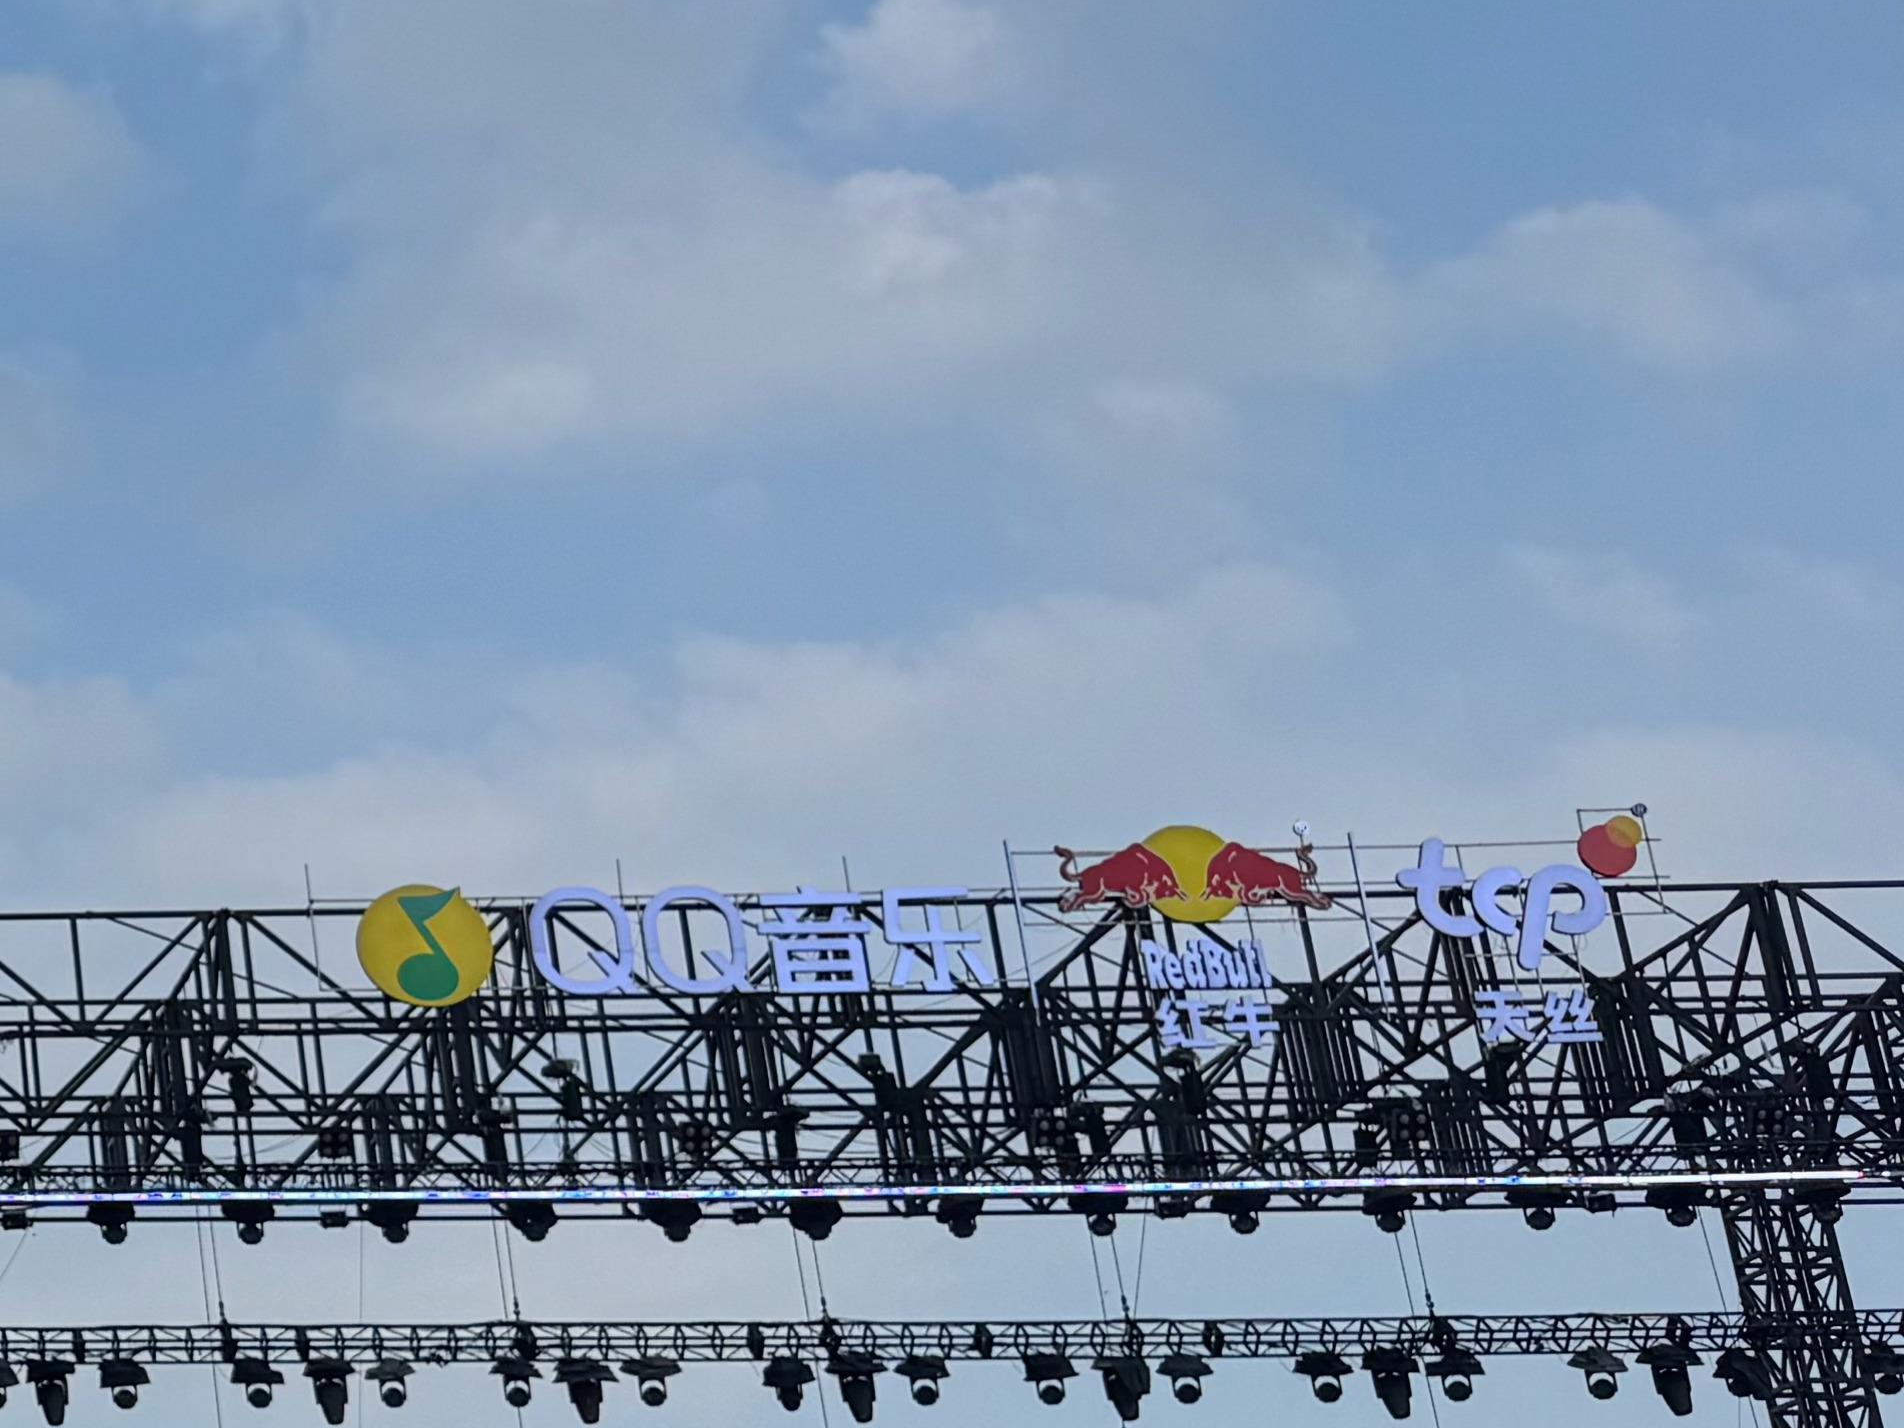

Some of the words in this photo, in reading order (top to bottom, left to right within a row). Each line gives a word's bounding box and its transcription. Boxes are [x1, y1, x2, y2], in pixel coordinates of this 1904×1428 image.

[529, 885, 994, 994] QQ音乐
[1396, 837, 1608, 970] tcp
[1155, 996, 1281, 1049] 红牛
[1474, 989, 1604, 1043] 天丝
